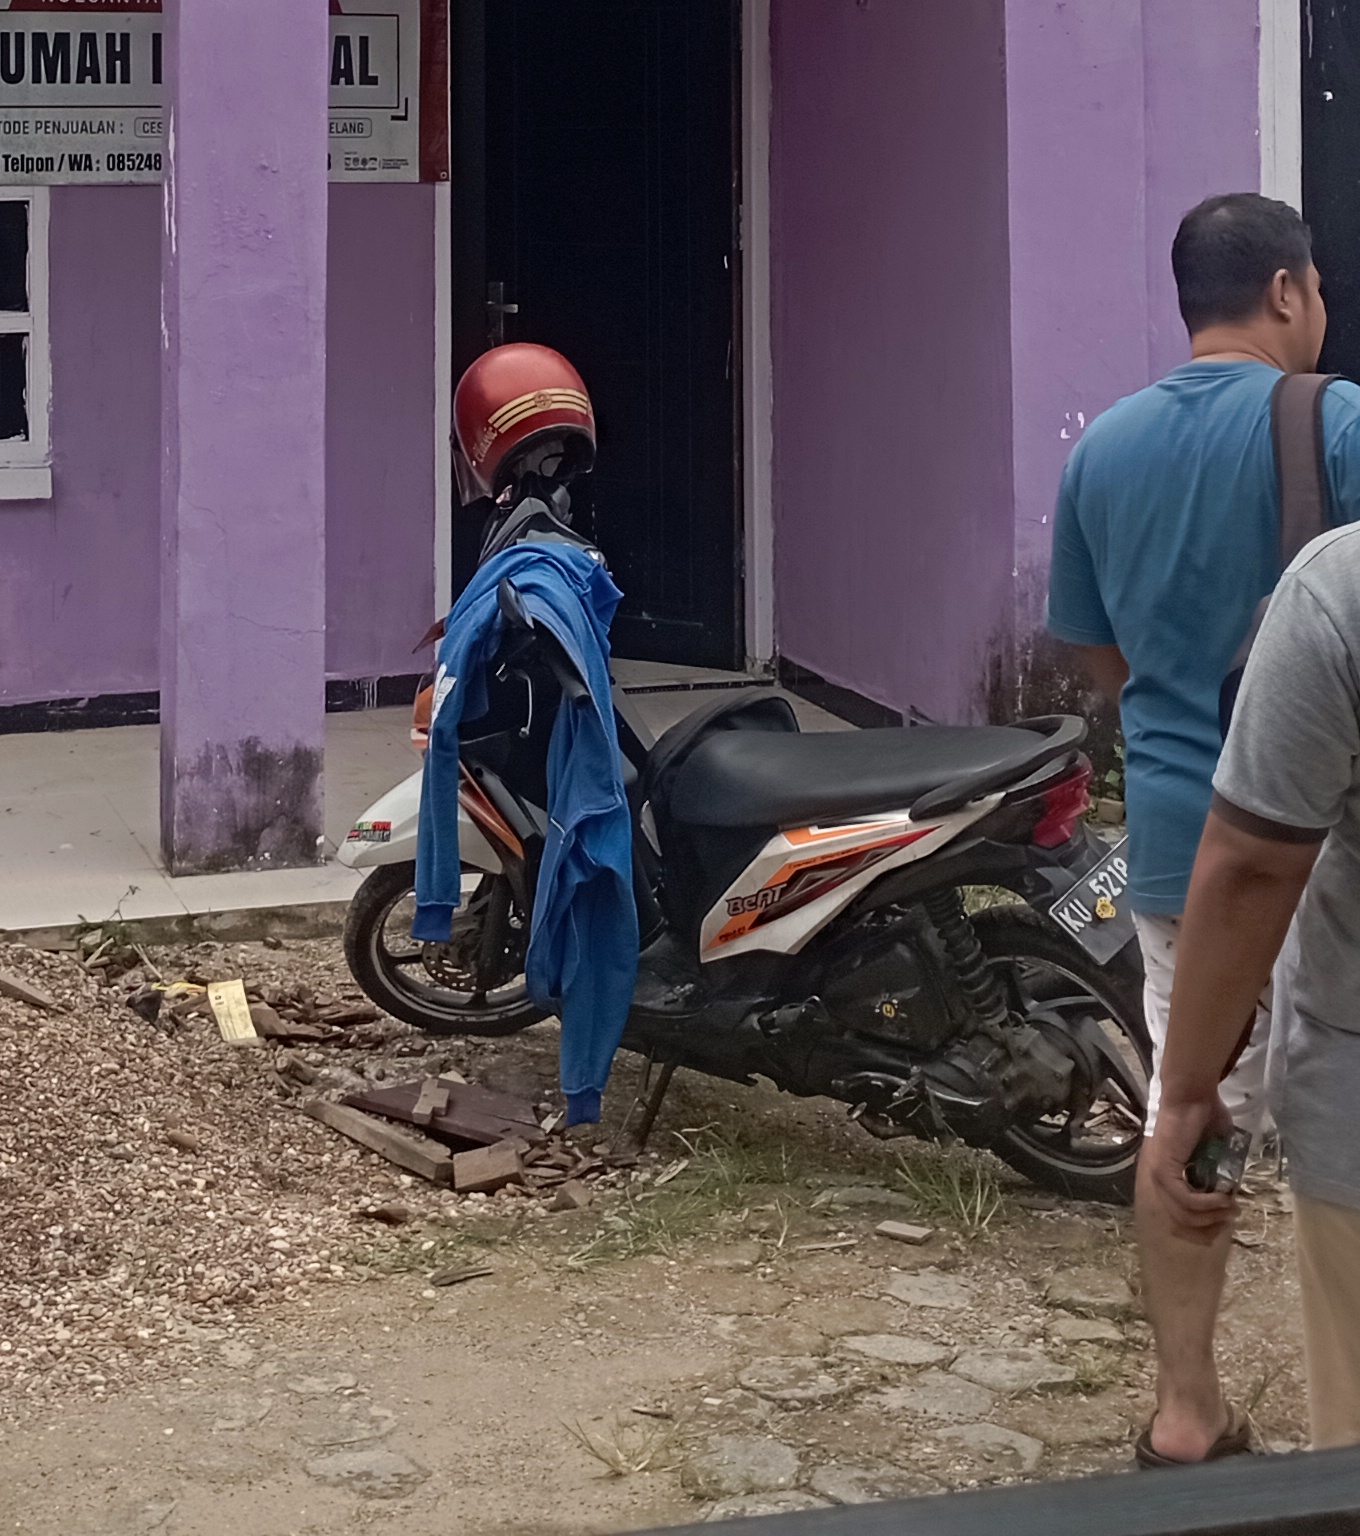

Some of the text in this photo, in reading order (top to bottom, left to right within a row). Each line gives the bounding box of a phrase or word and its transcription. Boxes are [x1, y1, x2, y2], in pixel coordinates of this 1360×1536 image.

[35, 120, 116, 135] PENJUALAN
[2, 153, 55, 174] Telpon
[1058, 898, 1093, 933] KU
